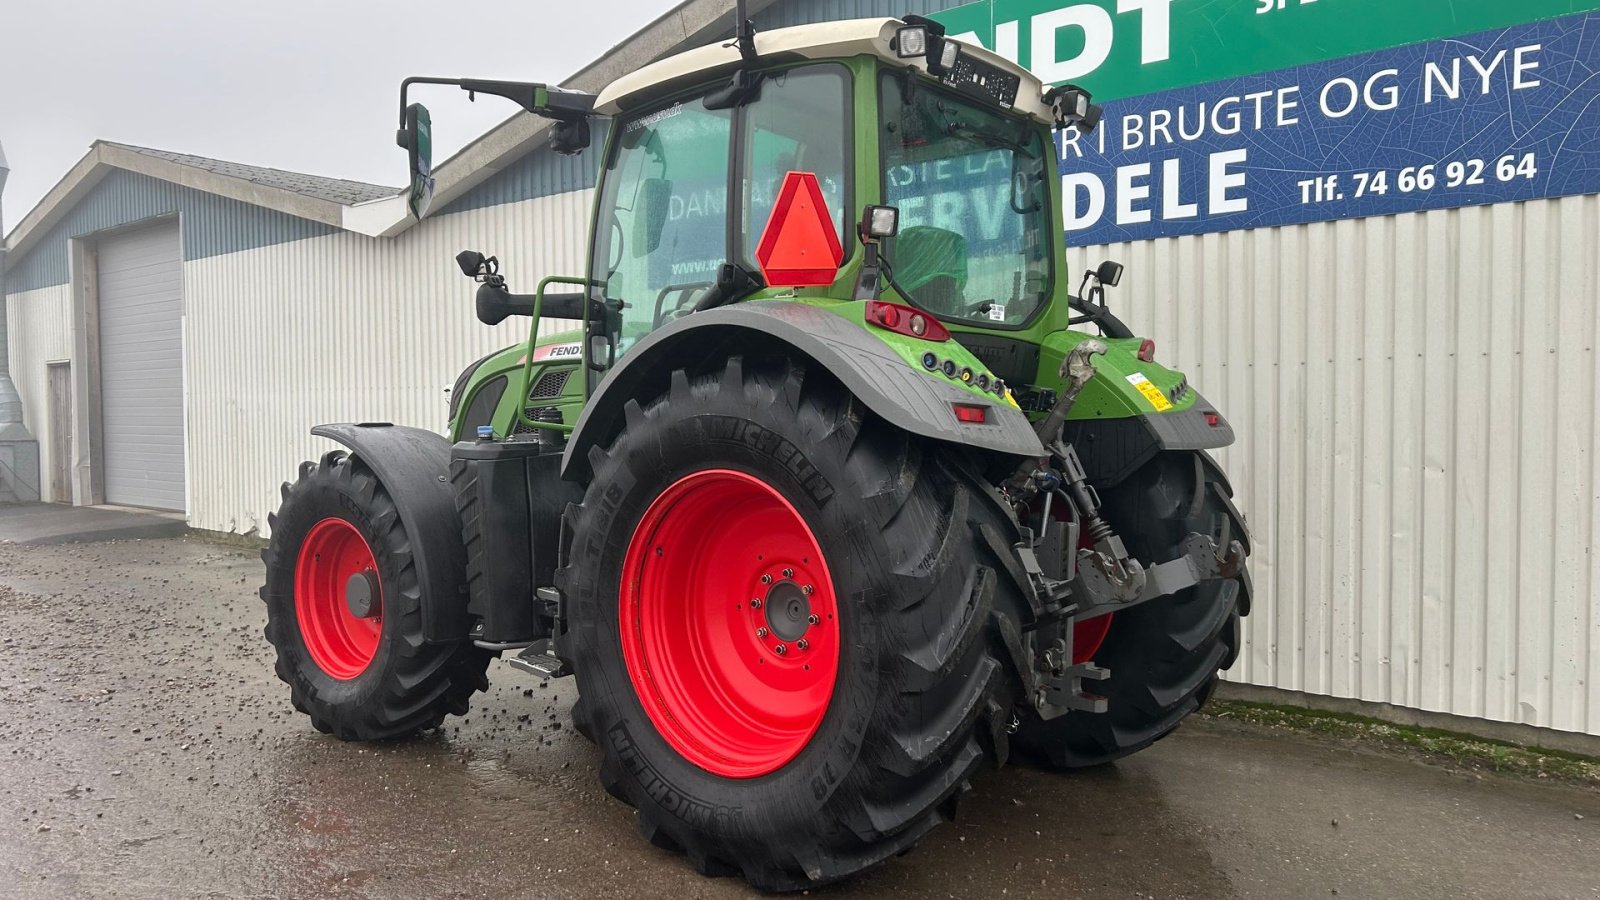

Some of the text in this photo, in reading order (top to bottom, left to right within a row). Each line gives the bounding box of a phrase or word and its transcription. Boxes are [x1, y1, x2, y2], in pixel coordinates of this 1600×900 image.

[1122, 86, 1300, 151] BRUGTE
[1319, 68, 1399, 119] OG
[1424, 43, 1542, 104] NYE
[1297, 152, 1538, 204] Tlf. 74 66 92 64
